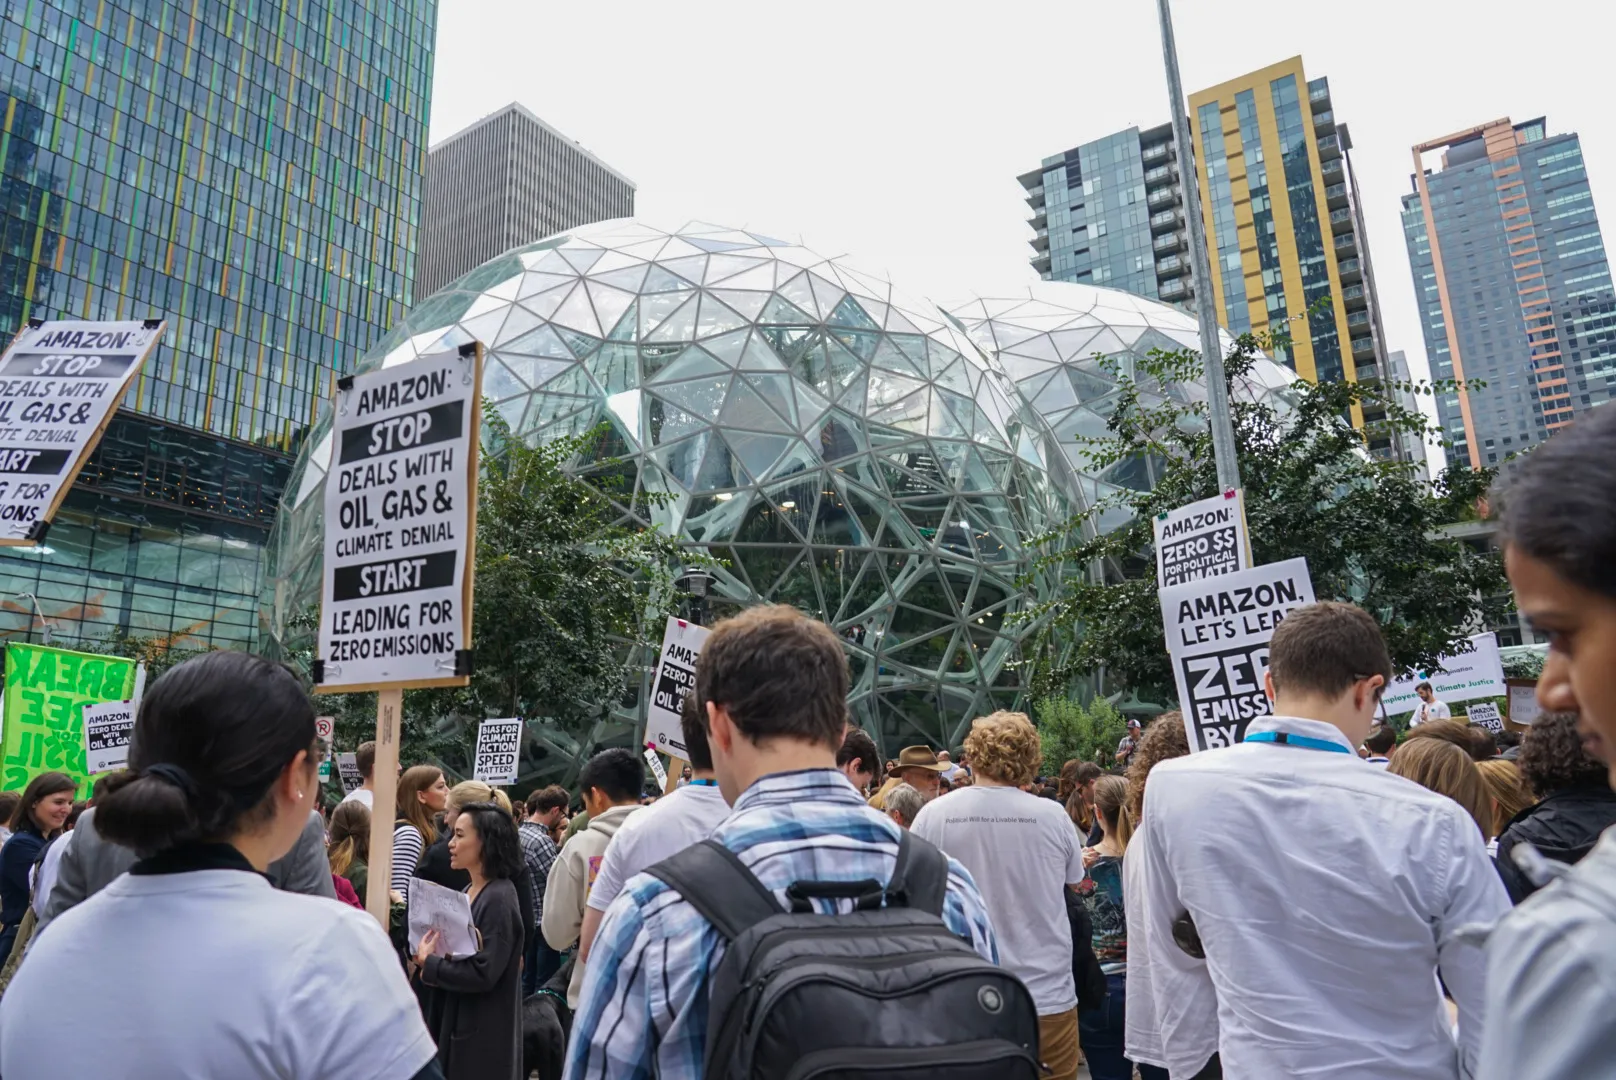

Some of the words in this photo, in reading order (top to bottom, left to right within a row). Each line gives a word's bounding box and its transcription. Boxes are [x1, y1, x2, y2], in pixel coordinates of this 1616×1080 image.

[35, 330, 135, 349] AMAZON:
[33, 355, 102, 376] STOP
[58, 382, 109, 398] WITH
[356, 368, 453, 416] AMAZON:
[20, 401, 70, 423] GAS
[69, 402, 91, 424] &
[25, 429, 79, 442] DENIAL
[368, 412, 432, 455] STOP
[0, 449, 41, 471] ART
[339, 460, 398, 494] DEALS
[405, 448, 453, 478] WITH
[12, 483, 50, 500] FOR
[340, 495, 379, 529] OIL,
[382, 484, 427, 521] GAS
[433, 479, 453, 514] &
[1162, 507, 1234, 540] AMAZON:
[336, 531, 393, 557] CLIMATE
[401, 522, 454, 547] DENIAL
[1164, 537, 1209, 565] ZERO
[1212, 528, 1235, 551] $$
[1164, 563, 1182, 577] FOR
[1183, 550, 1236, 573] POLITICAL
[359, 558, 427, 596] START
[1178, 578, 1304, 624] AMAZON,
[332, 604, 410, 635] LEADING
[419, 599, 453, 627] FOR
[1181, 618, 1236, 646] LET'S
[330, 638, 370, 661] ZERO
[373, 632, 455, 658] EMISSIONS
[663, 665, 687, 684] ZERO
[1435, 682, 1466, 693] Climate
[1468, 678, 1494, 689] Justice
[657, 691, 674, 710] OIL
[90, 726, 110, 735] ZERO
[111, 722, 133, 731] DEALS
[103, 731, 120, 739] WITH
[481, 732, 517, 743] CLIMATE
[482, 725, 500, 734] BIAS
[501, 724, 518, 733] FOR
[1202, 724, 1237, 750] BY
[91, 740, 105, 749] OIL
[107, 738, 115, 747] &
[480, 742, 516, 753] ACTION
[477, 766, 513, 774] MATTERS
[478, 754, 514, 766] SPEED
[945, 816, 969, 824] Political
